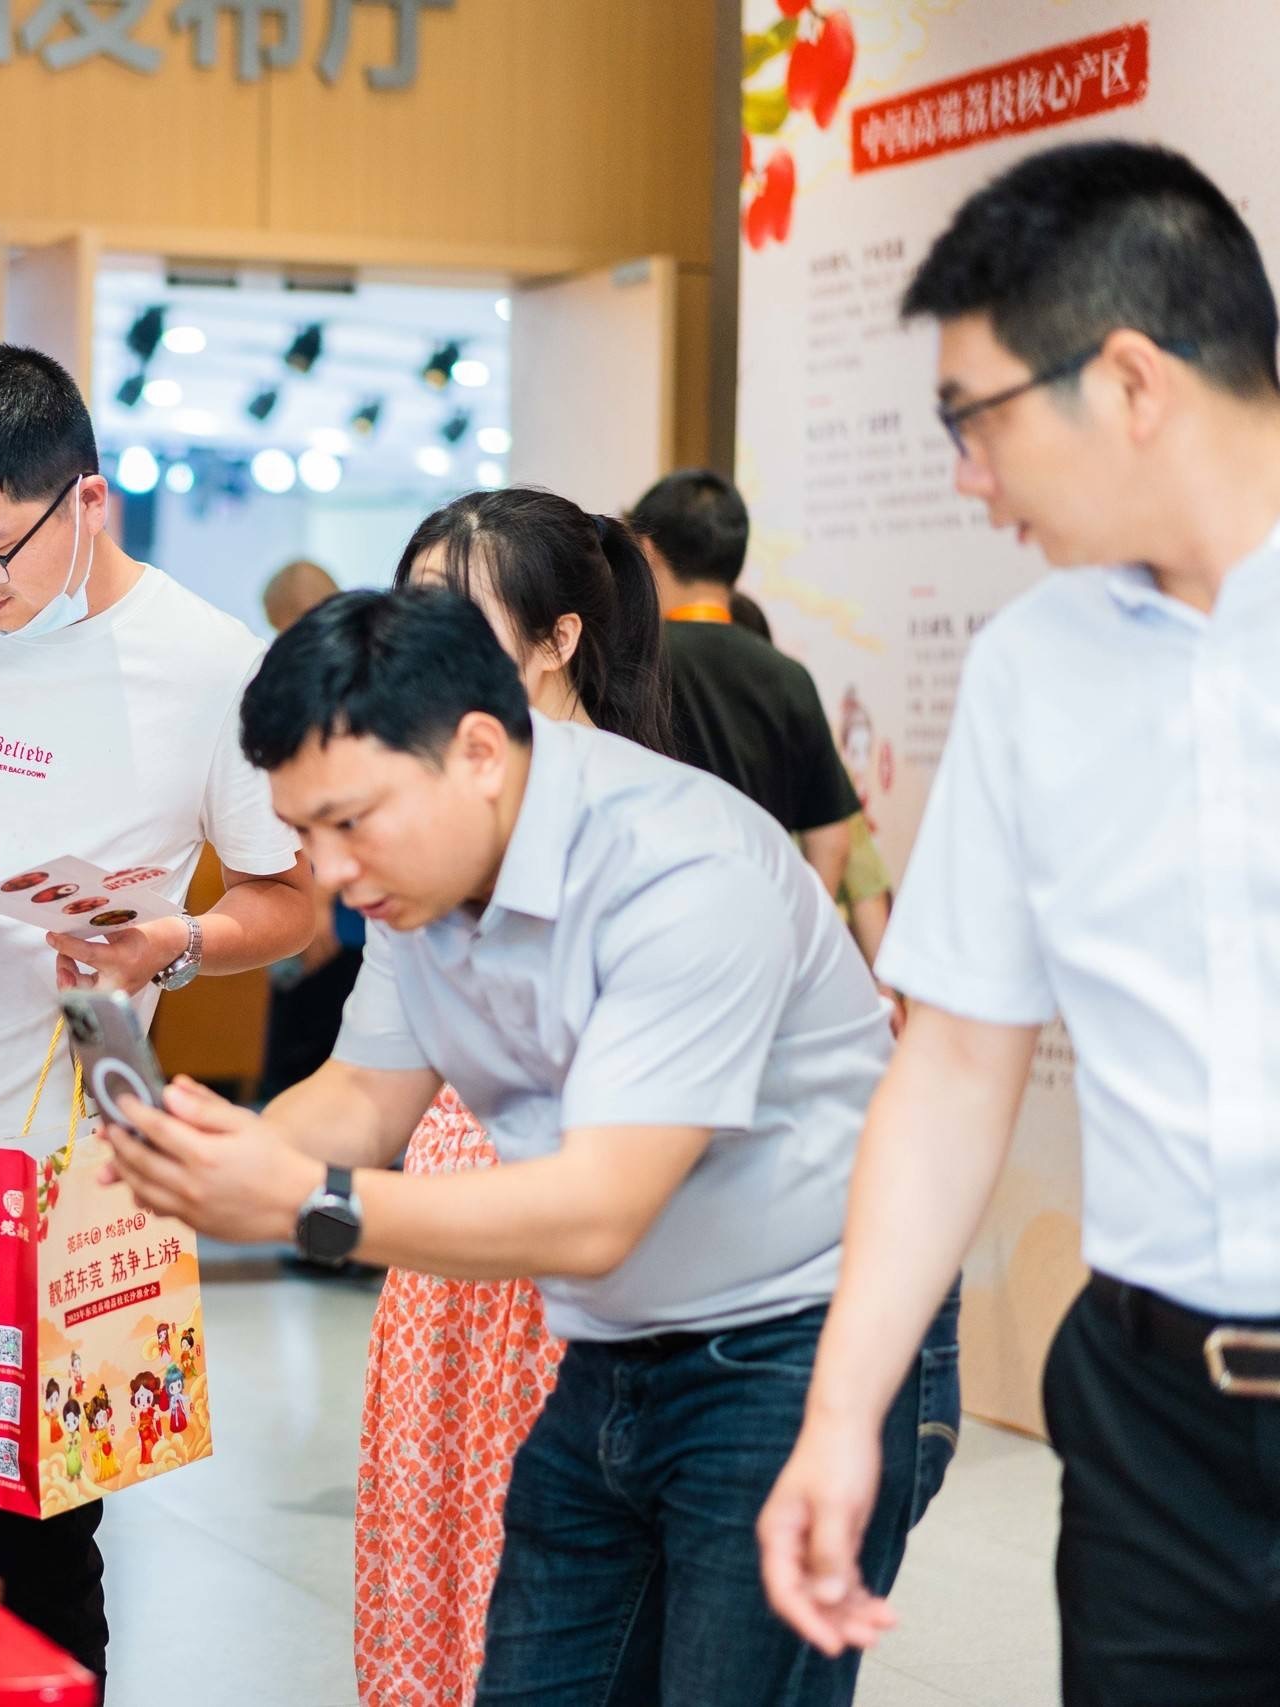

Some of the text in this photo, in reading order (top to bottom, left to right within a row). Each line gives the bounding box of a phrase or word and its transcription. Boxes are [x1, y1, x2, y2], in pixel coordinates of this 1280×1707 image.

[860, 43, 1131, 163] 中国高端荔枝核心产区
[8, 766, 26, 776] BACK
[26, 770, 47, 780] DOWN
[48, 1236, 181, 1307] 靓荔东莞 荔争上游
